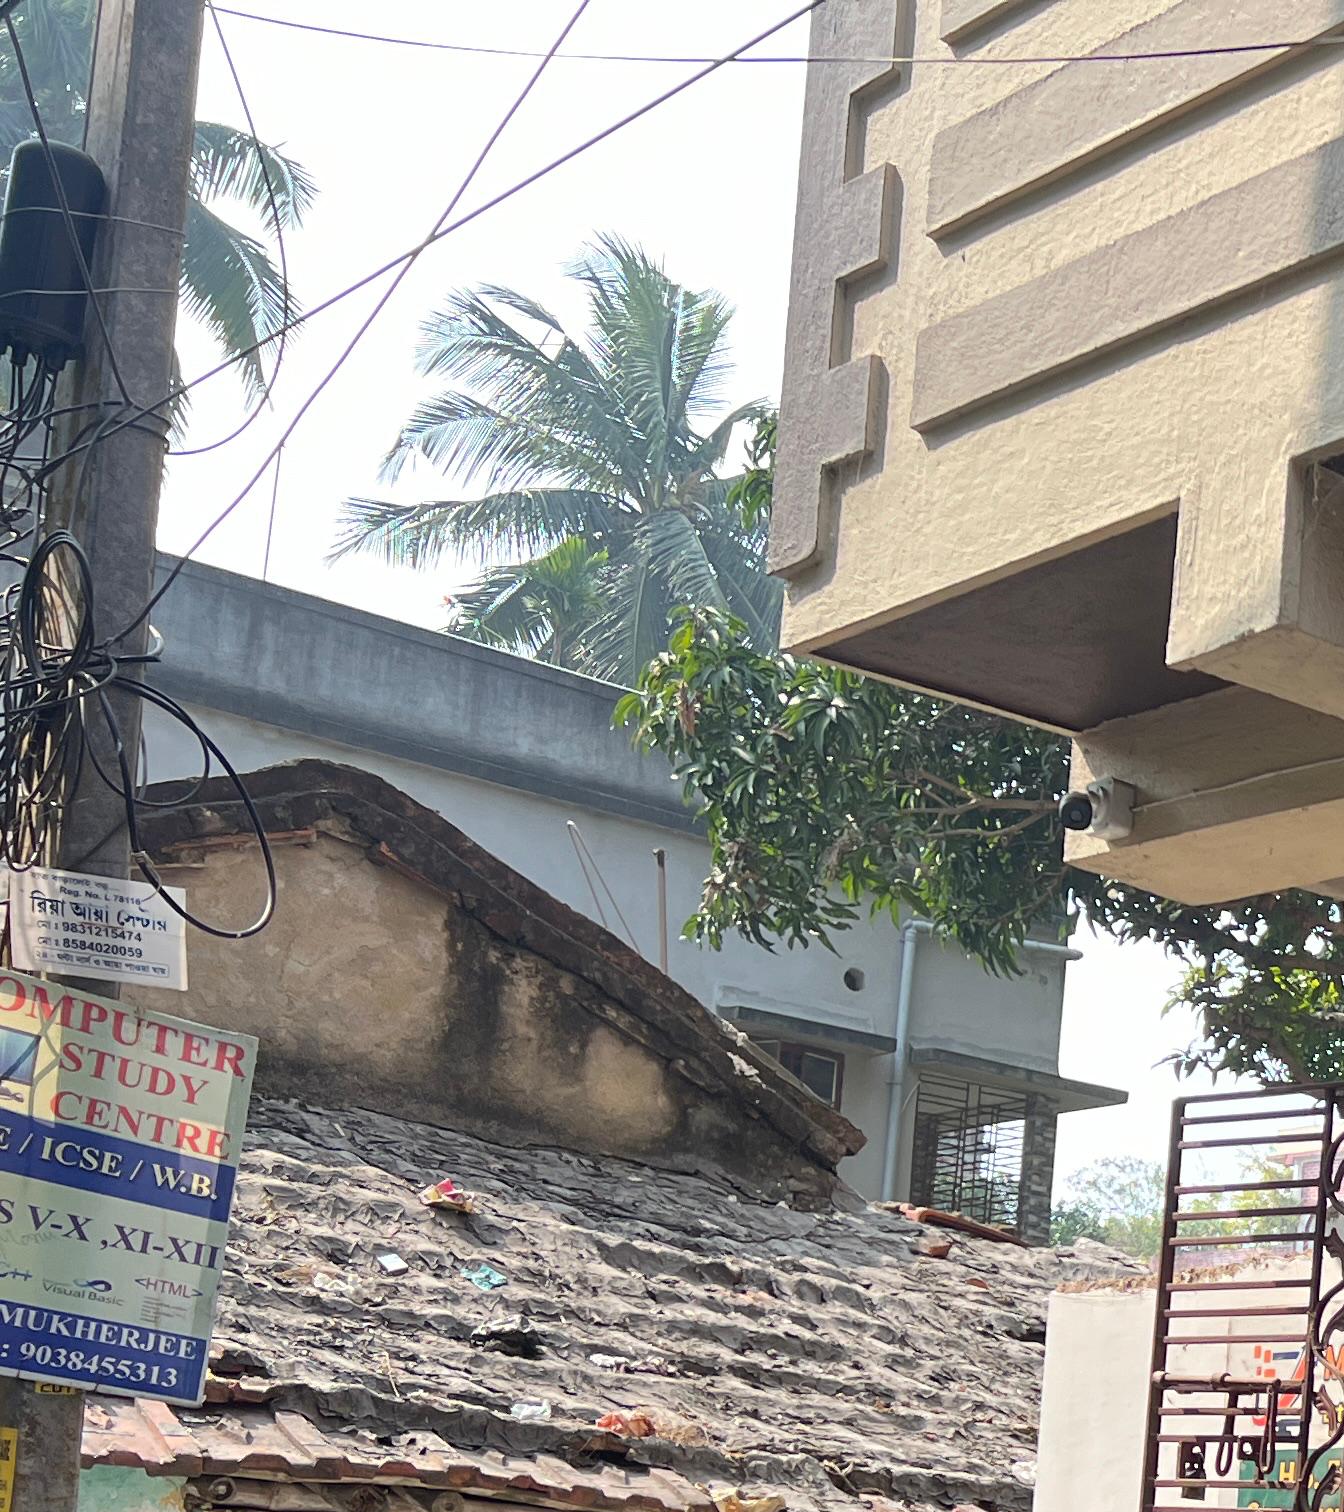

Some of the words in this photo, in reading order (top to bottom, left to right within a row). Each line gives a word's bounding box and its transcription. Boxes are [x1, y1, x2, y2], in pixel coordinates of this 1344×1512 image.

[30, 890, 65, 917] রিয়া
[69, 901, 109, 924] আয়া
[62, 921, 142, 942] 9831215474
[63, 938, 143, 958] 8584020059
[60, 1041, 209, 1105] STUDY
[50, 1090, 231, 1161] CENTRE
[40, 1136, 122, 1177] ICSE
[28, 1204, 93, 1242] V-X
[42, 1282, 85, 1299] Visual
[87, 1290, 124, 1306] Basic
[0, 1303, 198, 1360] MUKHERJEE
[20, 1342, 178, 1389] 9038455313
